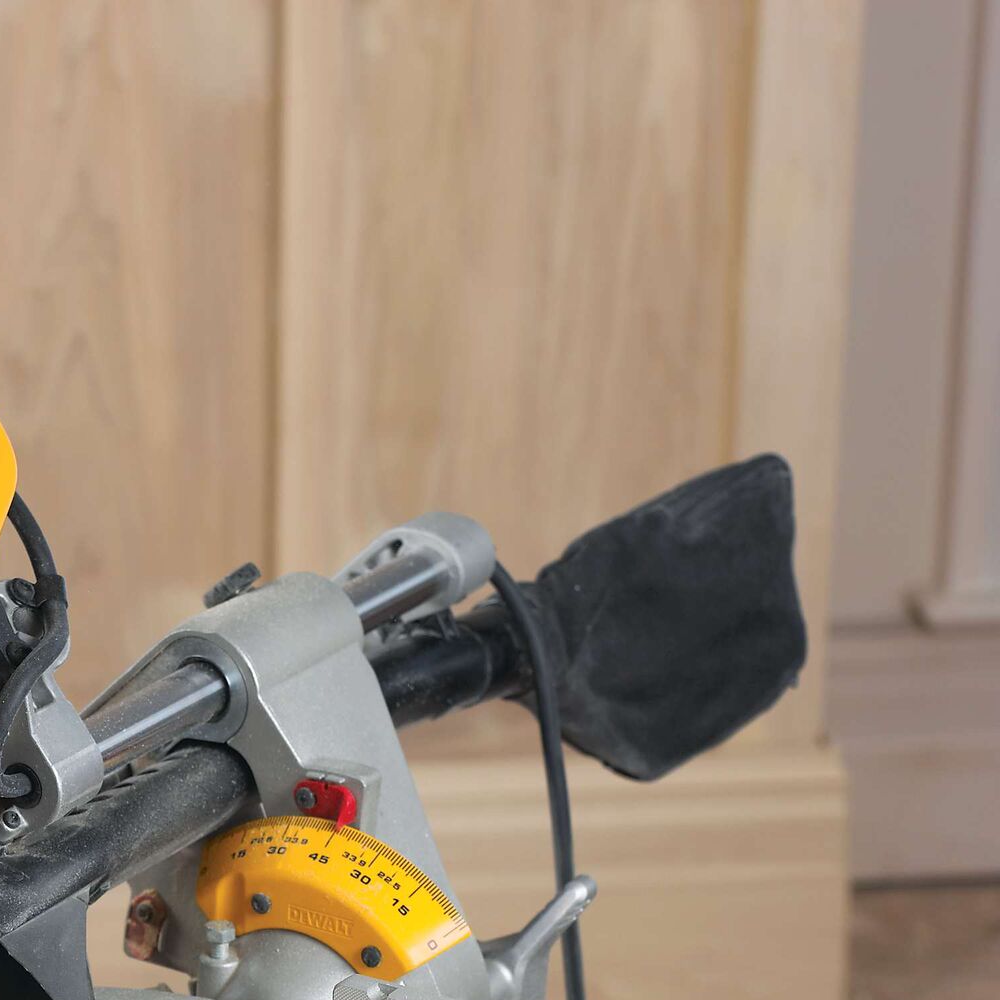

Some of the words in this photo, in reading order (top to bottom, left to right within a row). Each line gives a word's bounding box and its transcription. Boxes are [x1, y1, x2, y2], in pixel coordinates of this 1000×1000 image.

[267, 846, 287, 855] 30
[308, 853, 330, 865] 45
[350, 869, 372, 885] 30
[392, 898, 410, 916] 15
[288, 906, 350, 936] DEWALT
